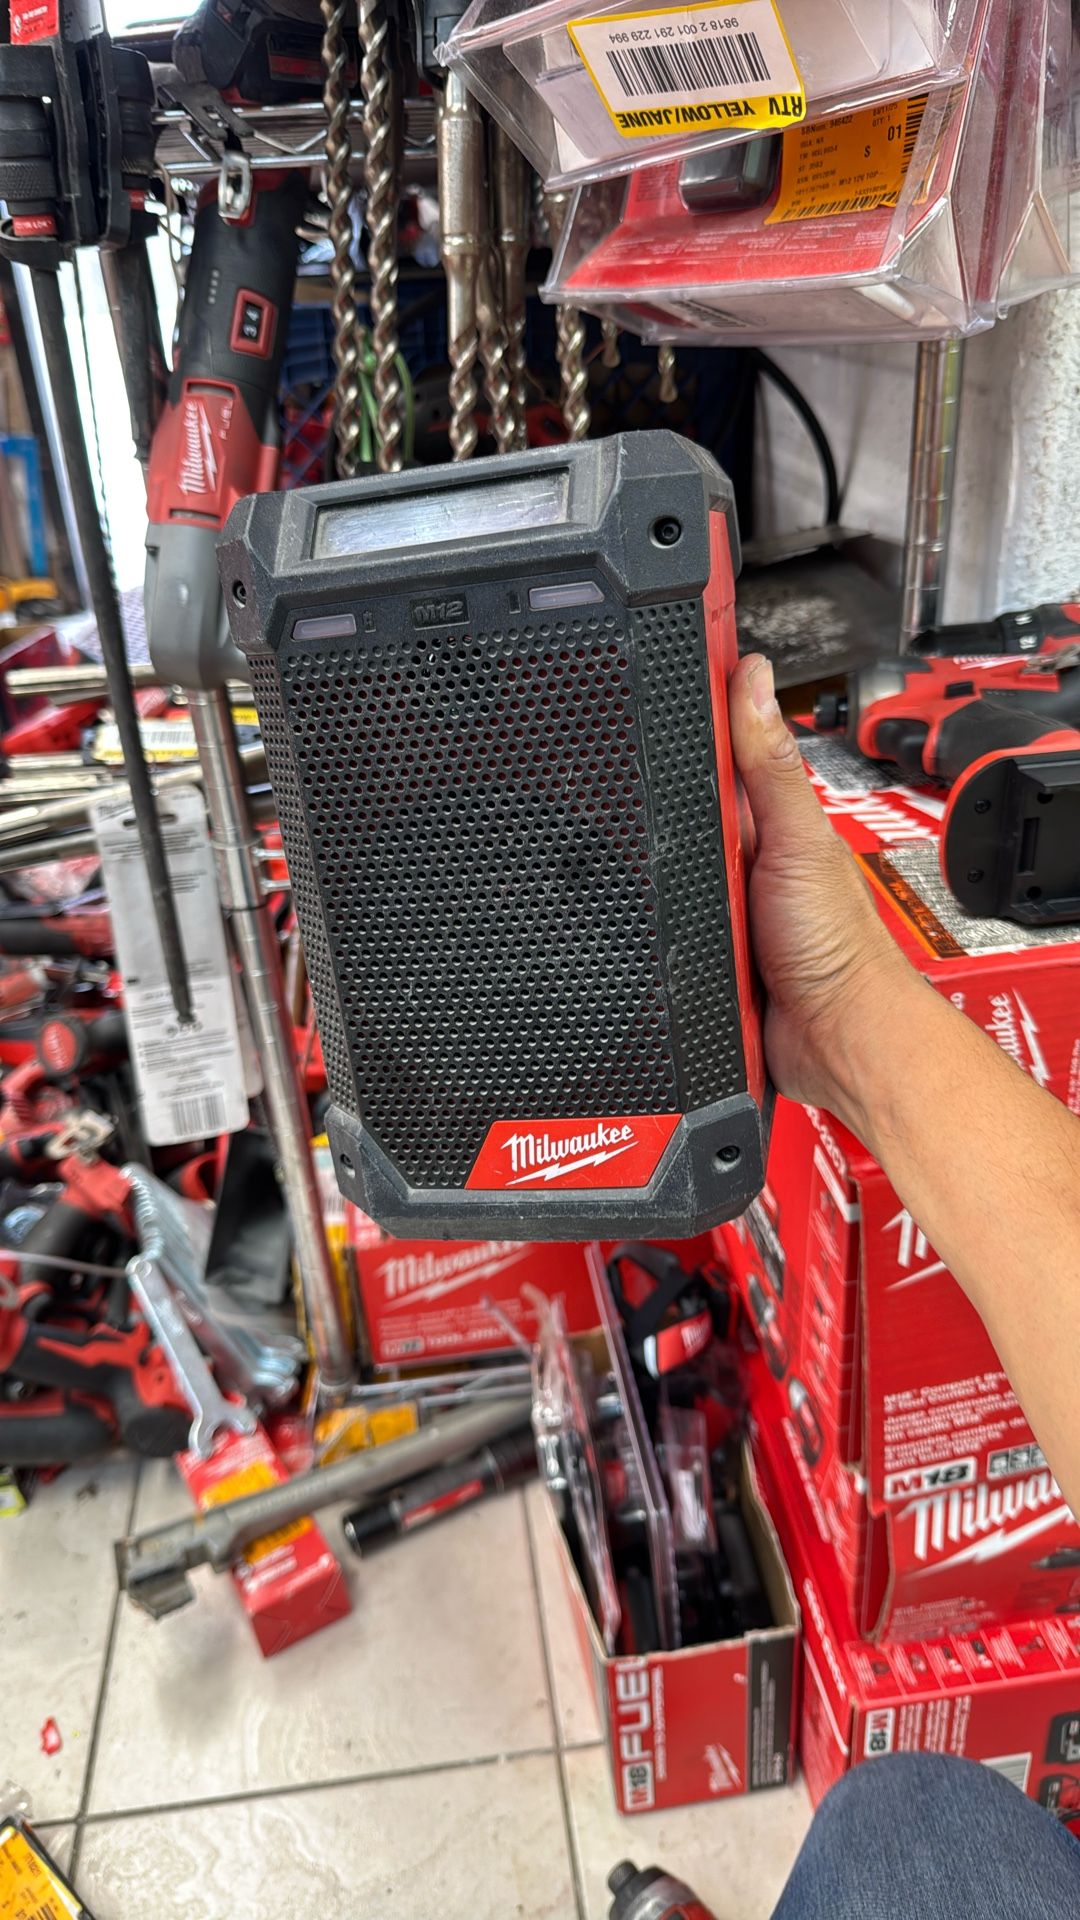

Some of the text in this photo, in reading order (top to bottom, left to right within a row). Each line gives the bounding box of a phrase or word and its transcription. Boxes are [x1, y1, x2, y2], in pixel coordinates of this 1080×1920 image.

[608, 17, 739, 44] 9818 2 001 291 229 994
[615, 96, 802, 129] RTV YELLOW/JAUNE
[887, 124, 902, 141] 01
[863, 145, 871, 158] S
[178, 400, 207, 496] Milwaukee
[414, 599, 464, 623] M12
[500, 1122, 635, 1172] Milwaukee
[891, 1463, 970, 1496] M18
[615, 1656, 653, 1763] FUEL
[868, 1710, 890, 1753] M18
[627, 1764, 652, 1809] M18
